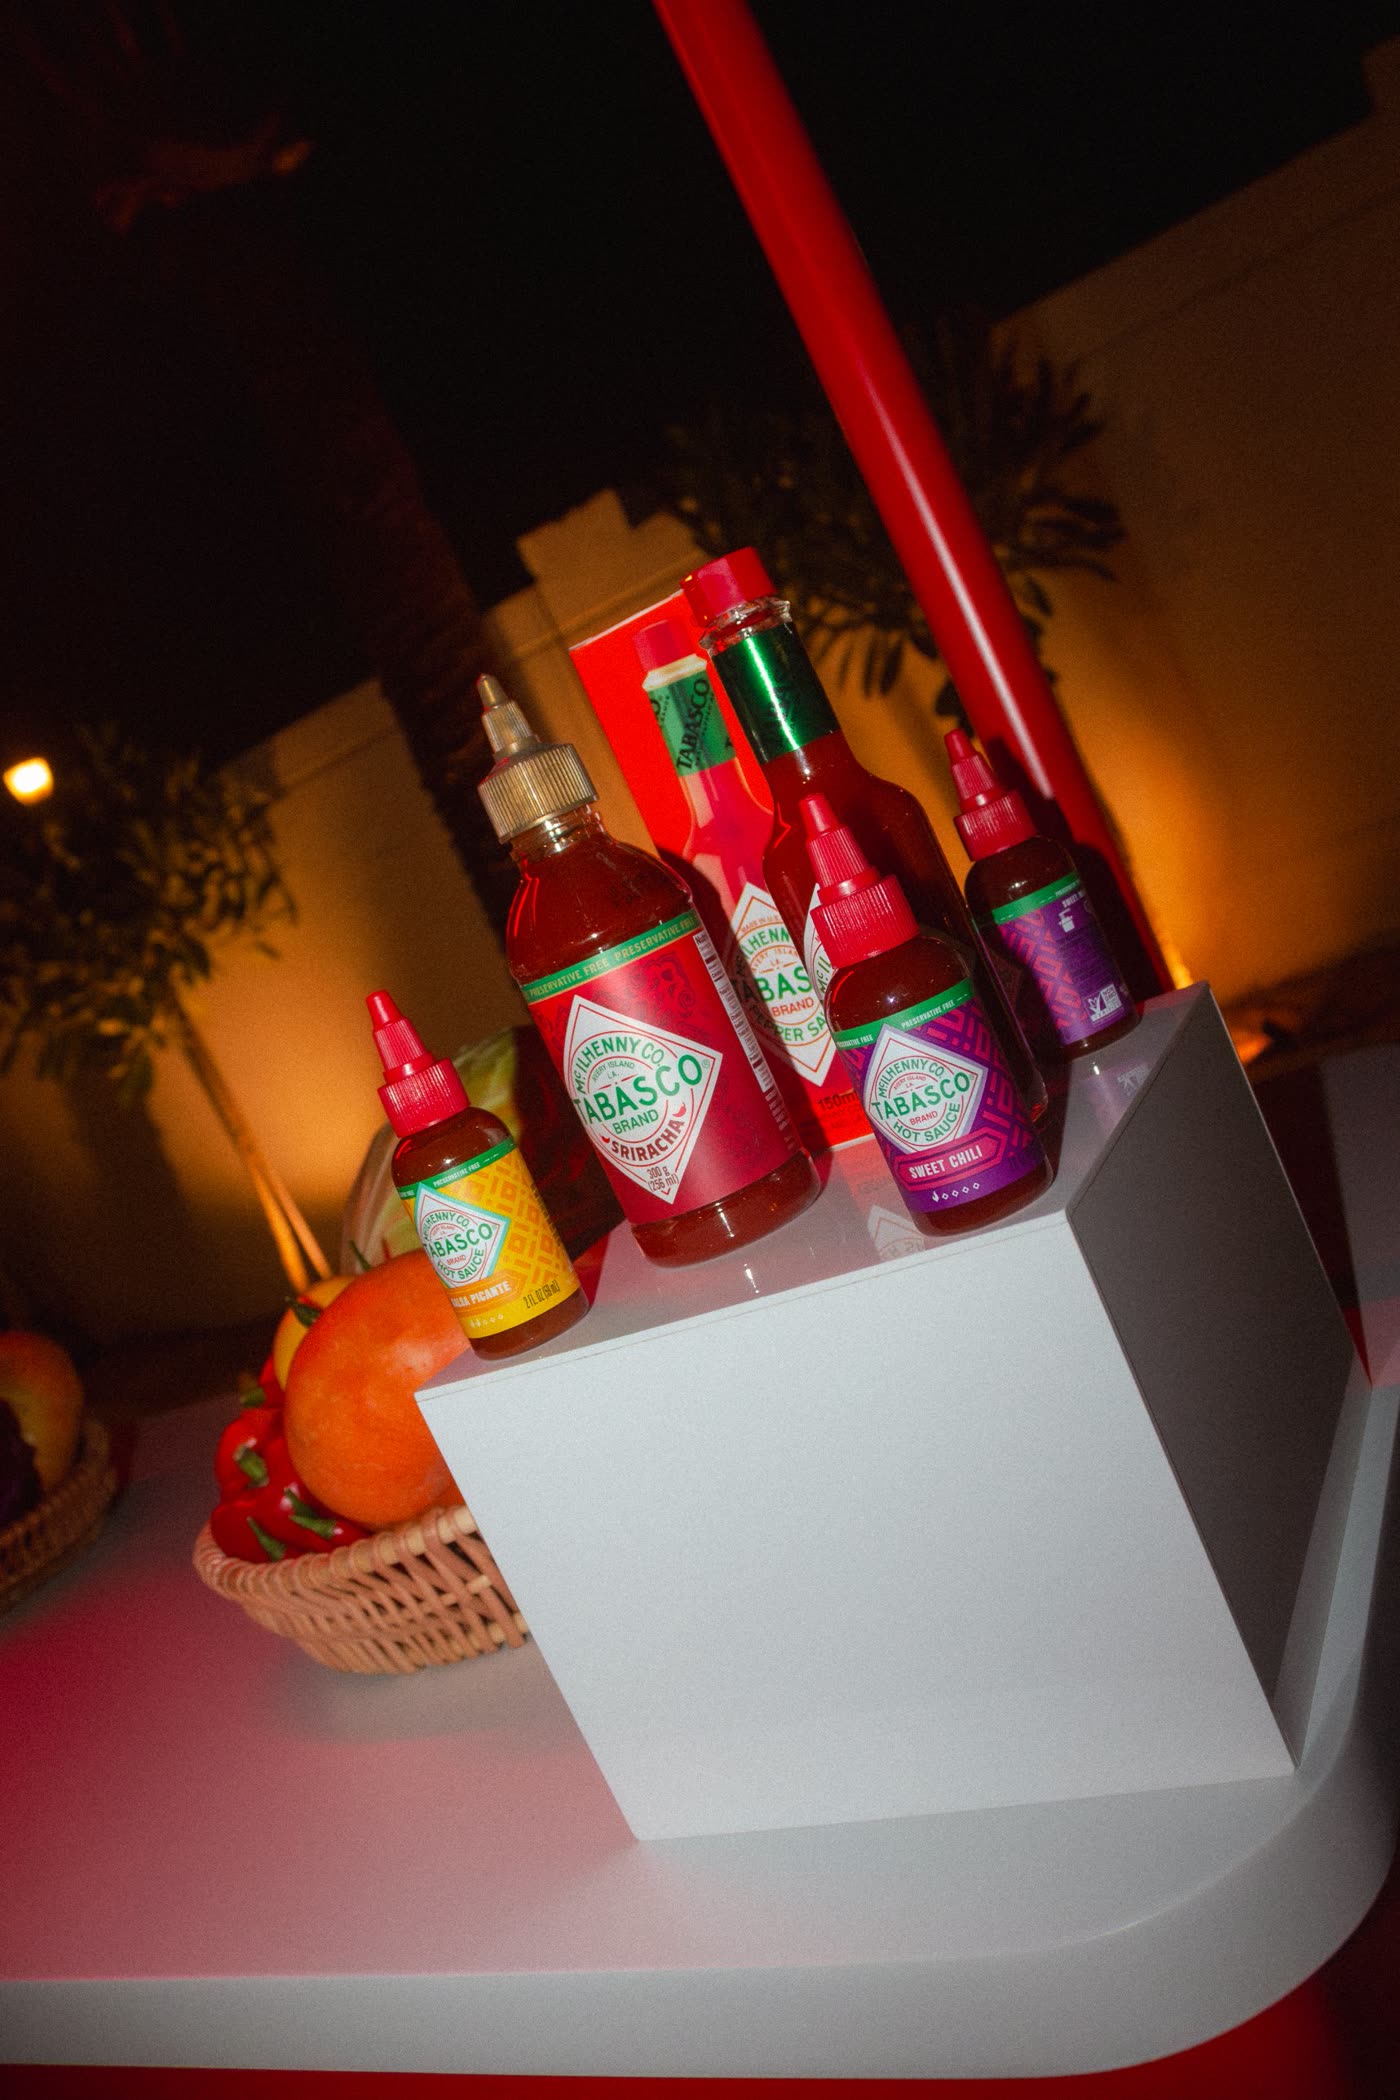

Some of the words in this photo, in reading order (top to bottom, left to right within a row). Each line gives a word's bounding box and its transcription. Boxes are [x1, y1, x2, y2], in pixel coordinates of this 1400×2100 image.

[676, 679, 710, 770] TABASCO
[529, 971, 581, 997] PRESERVATIVE
[583, 957, 610, 977] FREE
[614, 926, 681, 962] PRESERVATIVE
[772, 997, 815, 1018] BRAND
[901, 1007, 942, 1029] PRESERVATIVE
[942, 999, 955, 1013] FREE
[608, 1060, 635, 1071] ISLAND
[641, 1042, 665, 1067] CO.
[906, 1074, 928, 1083] ISLAND
[929, 1063, 946, 1079] CO.
[573, 1054, 703, 1126] TABASCO
[871, 1071, 971, 1122] TABASCO
[612, 1109, 660, 1135] BRAND
[893, 1121, 918, 1143] HOT
[924, 1102, 961, 1142] SAUCE
[909, 1110, 939, 1127] BRAND
[611, 1119, 686, 1162] SRIRACHA
[647, 1167, 662, 1180] 300
[909, 1159, 946, 1179] SWEET
[949, 1145, 984, 1169] CHILI
[647, 1177, 666, 1192] (256
[423, 1223, 493, 1258] ABASCO
[437, 1261, 456, 1278] HOT
[457, 1249, 485, 1280] SAUCE
[470, 1280, 513, 1305] PICANTE
